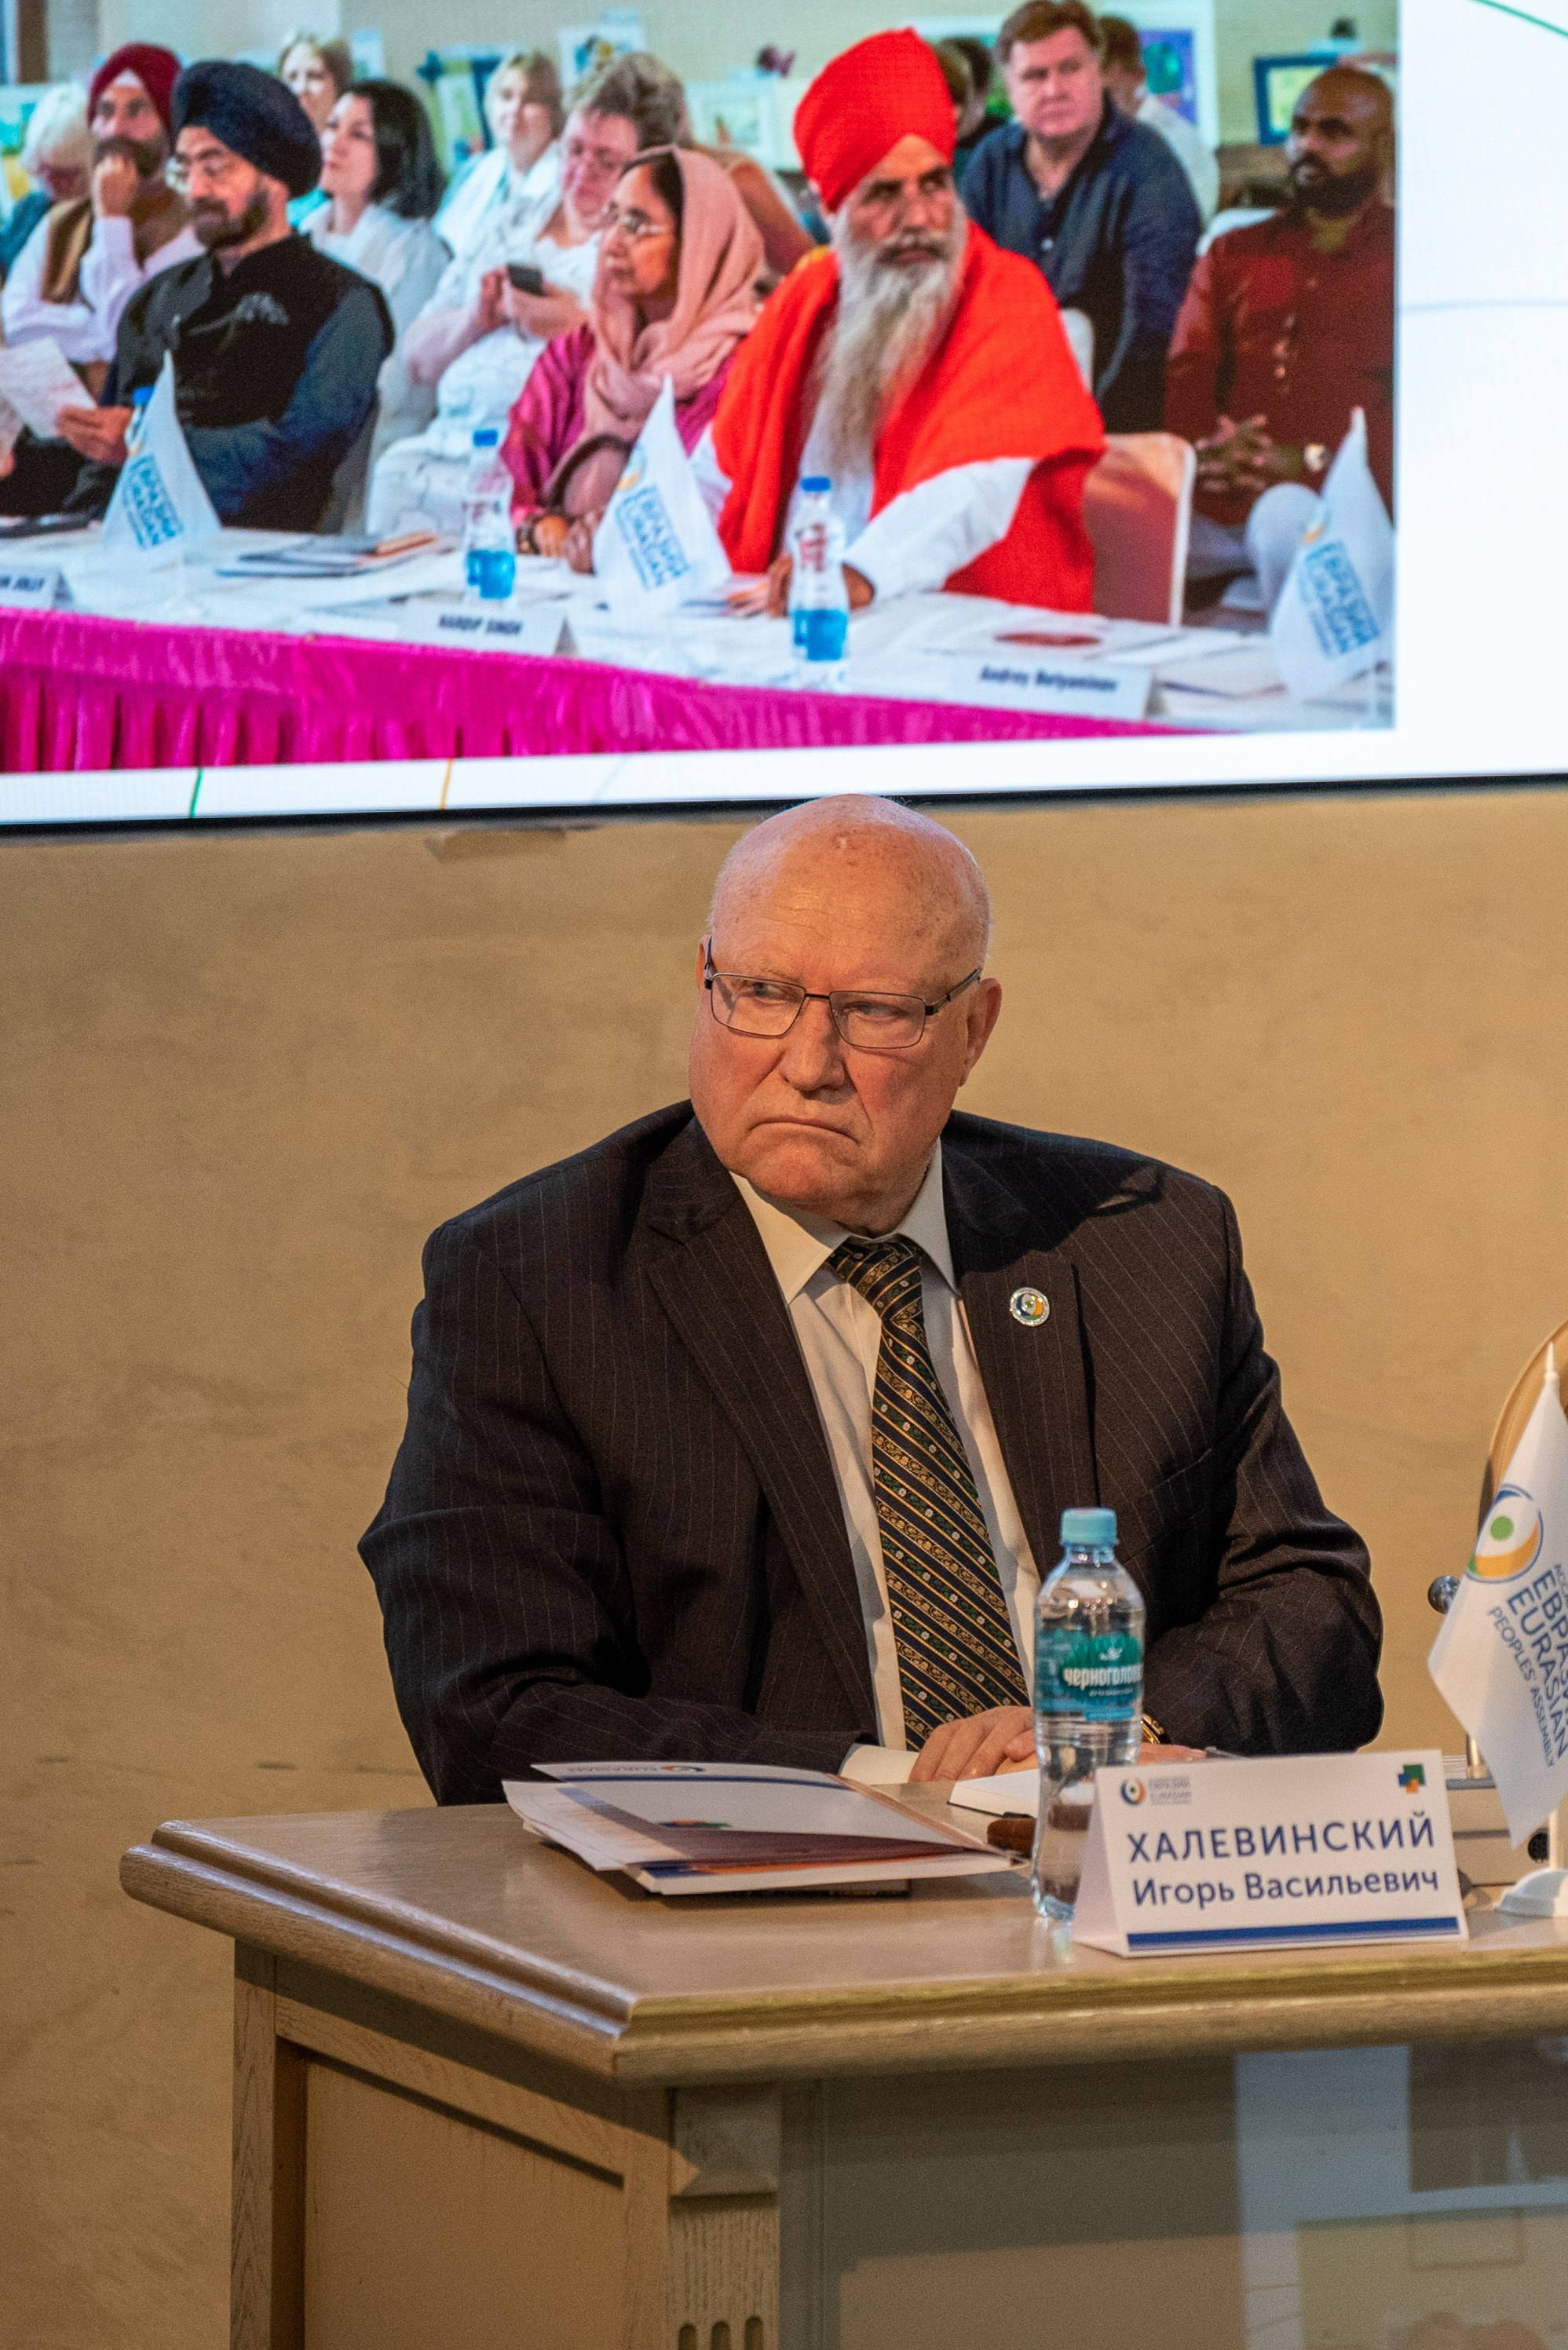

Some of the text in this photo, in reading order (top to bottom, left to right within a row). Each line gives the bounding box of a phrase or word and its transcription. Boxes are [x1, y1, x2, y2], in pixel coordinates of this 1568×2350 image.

[1507, 1587, 1568, 1759] EURASIAN
[1530, 1687, 1555, 1767] ASSEMBLY
[1127, 1809, 1435, 1863] ХАЛЕВИНСКИЙ
[1133, 1868, 1439, 1910] Игорь Васильевич
